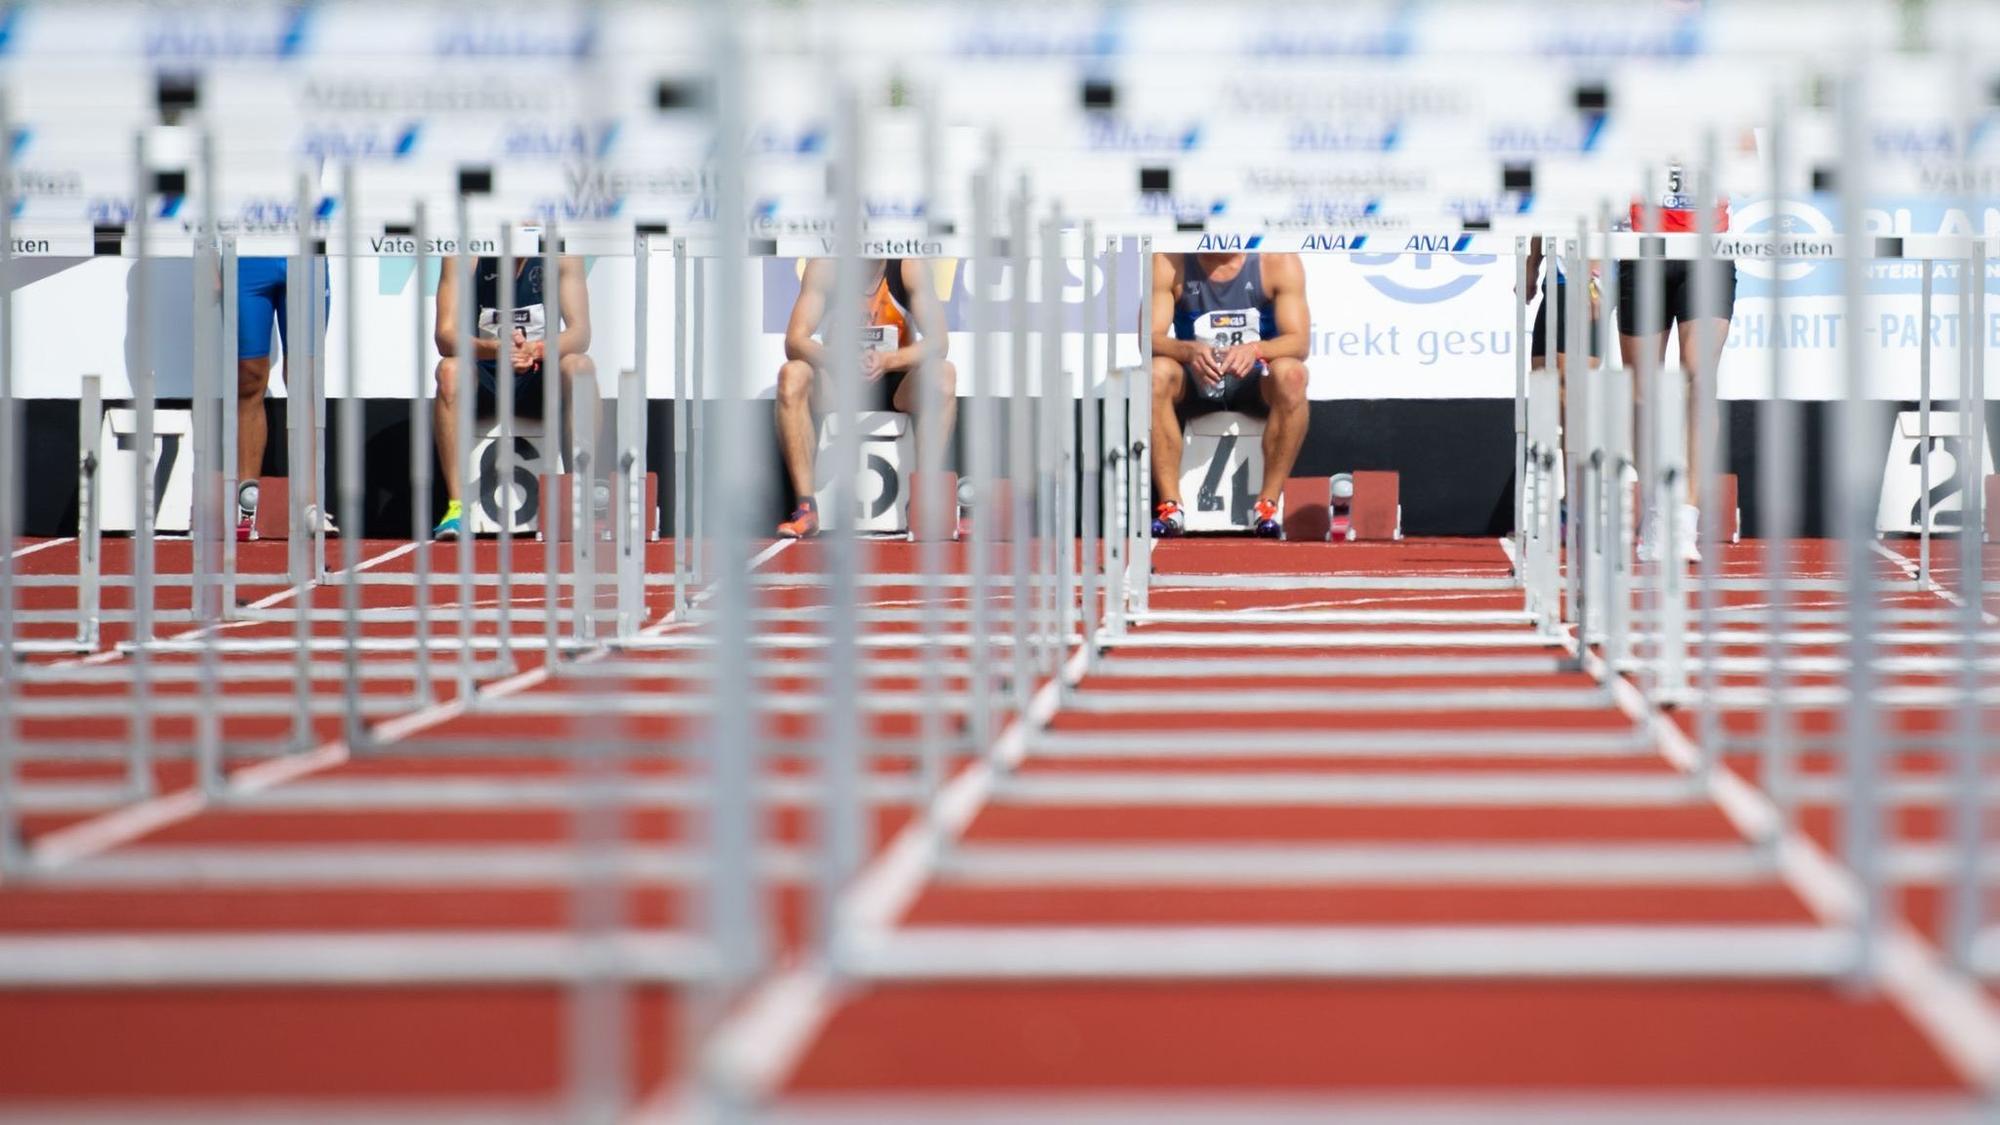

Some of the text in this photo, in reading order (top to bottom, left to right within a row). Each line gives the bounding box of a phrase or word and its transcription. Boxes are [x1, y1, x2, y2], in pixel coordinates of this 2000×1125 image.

[370, 236, 495, 253] Vatesteen
[1196, 234, 1241, 250] ANA
[1301, 234, 1346, 250] ANA
[1404, 235, 1449, 251] ANA
[1711, 239, 1834, 256] Vatersetten
[117, 434, 180, 528] 7
[480, 436, 540, 526] 6
[1197, 434, 1262, 525] 4
[1910, 436, 1975, 525] 2
